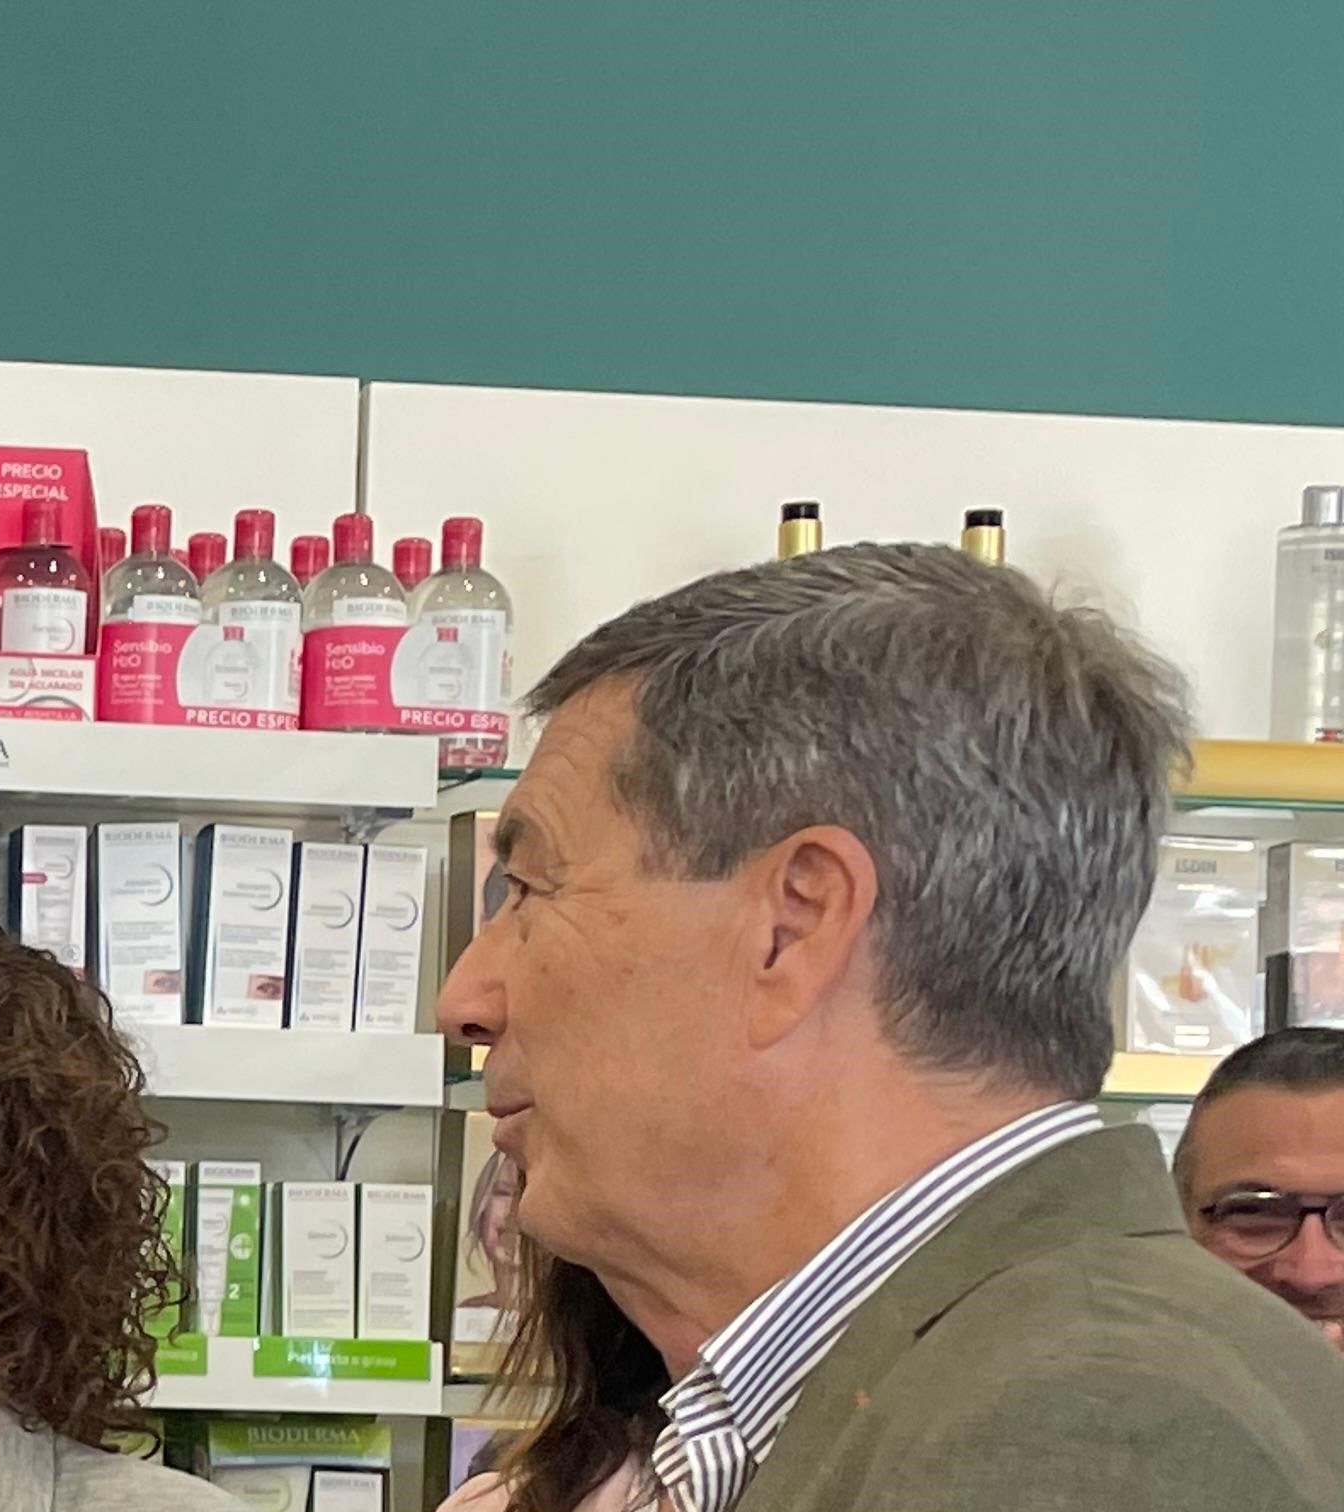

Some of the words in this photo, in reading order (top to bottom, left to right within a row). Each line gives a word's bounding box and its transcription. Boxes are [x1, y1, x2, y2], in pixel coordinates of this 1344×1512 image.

[0, 461, 62, 480] PRECIO
[113, 640, 173, 655] Sensibio
[325, 642, 385, 656] Sensibio
[185, 708, 251, 727] PRECIO
[400, 710, 465, 728] PRECIO
[105, 831, 174, 843] BIODERMA
[219, 833, 288, 848] BIODERMA
[228, 1283, 240, 1300] 2
[247, 1426, 361, 1444] BIODERMA
